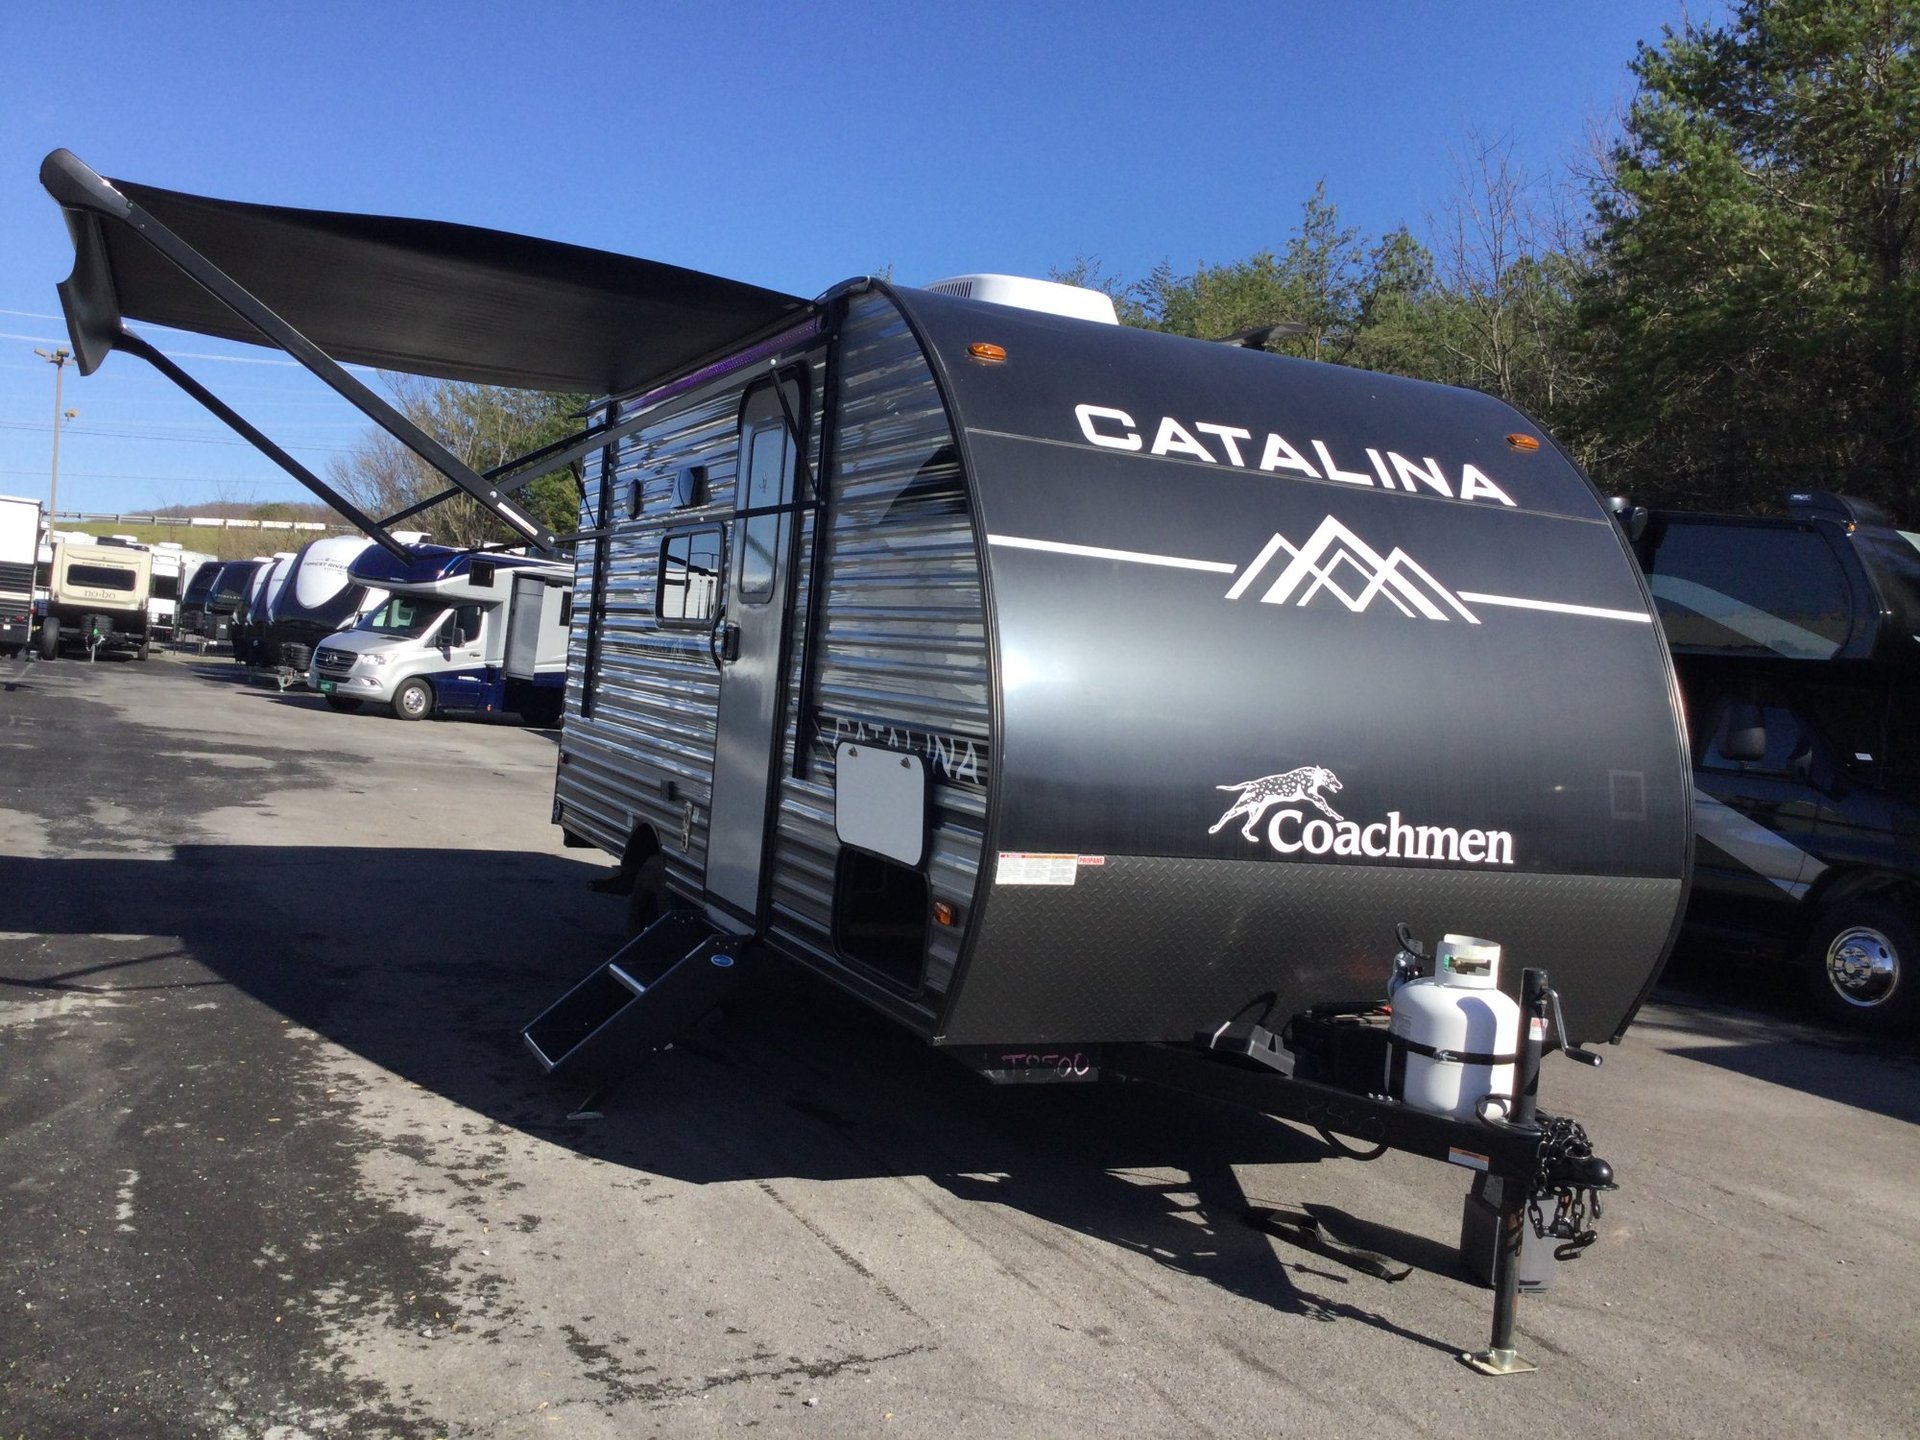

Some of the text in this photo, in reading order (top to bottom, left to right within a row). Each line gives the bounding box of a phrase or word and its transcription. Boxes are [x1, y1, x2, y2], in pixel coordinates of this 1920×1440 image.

[1074, 404, 1517, 506] CATALINA
[1079, 856, 1104, 864] PROPANE
[1267, 809, 1515, 865] Coachmen
